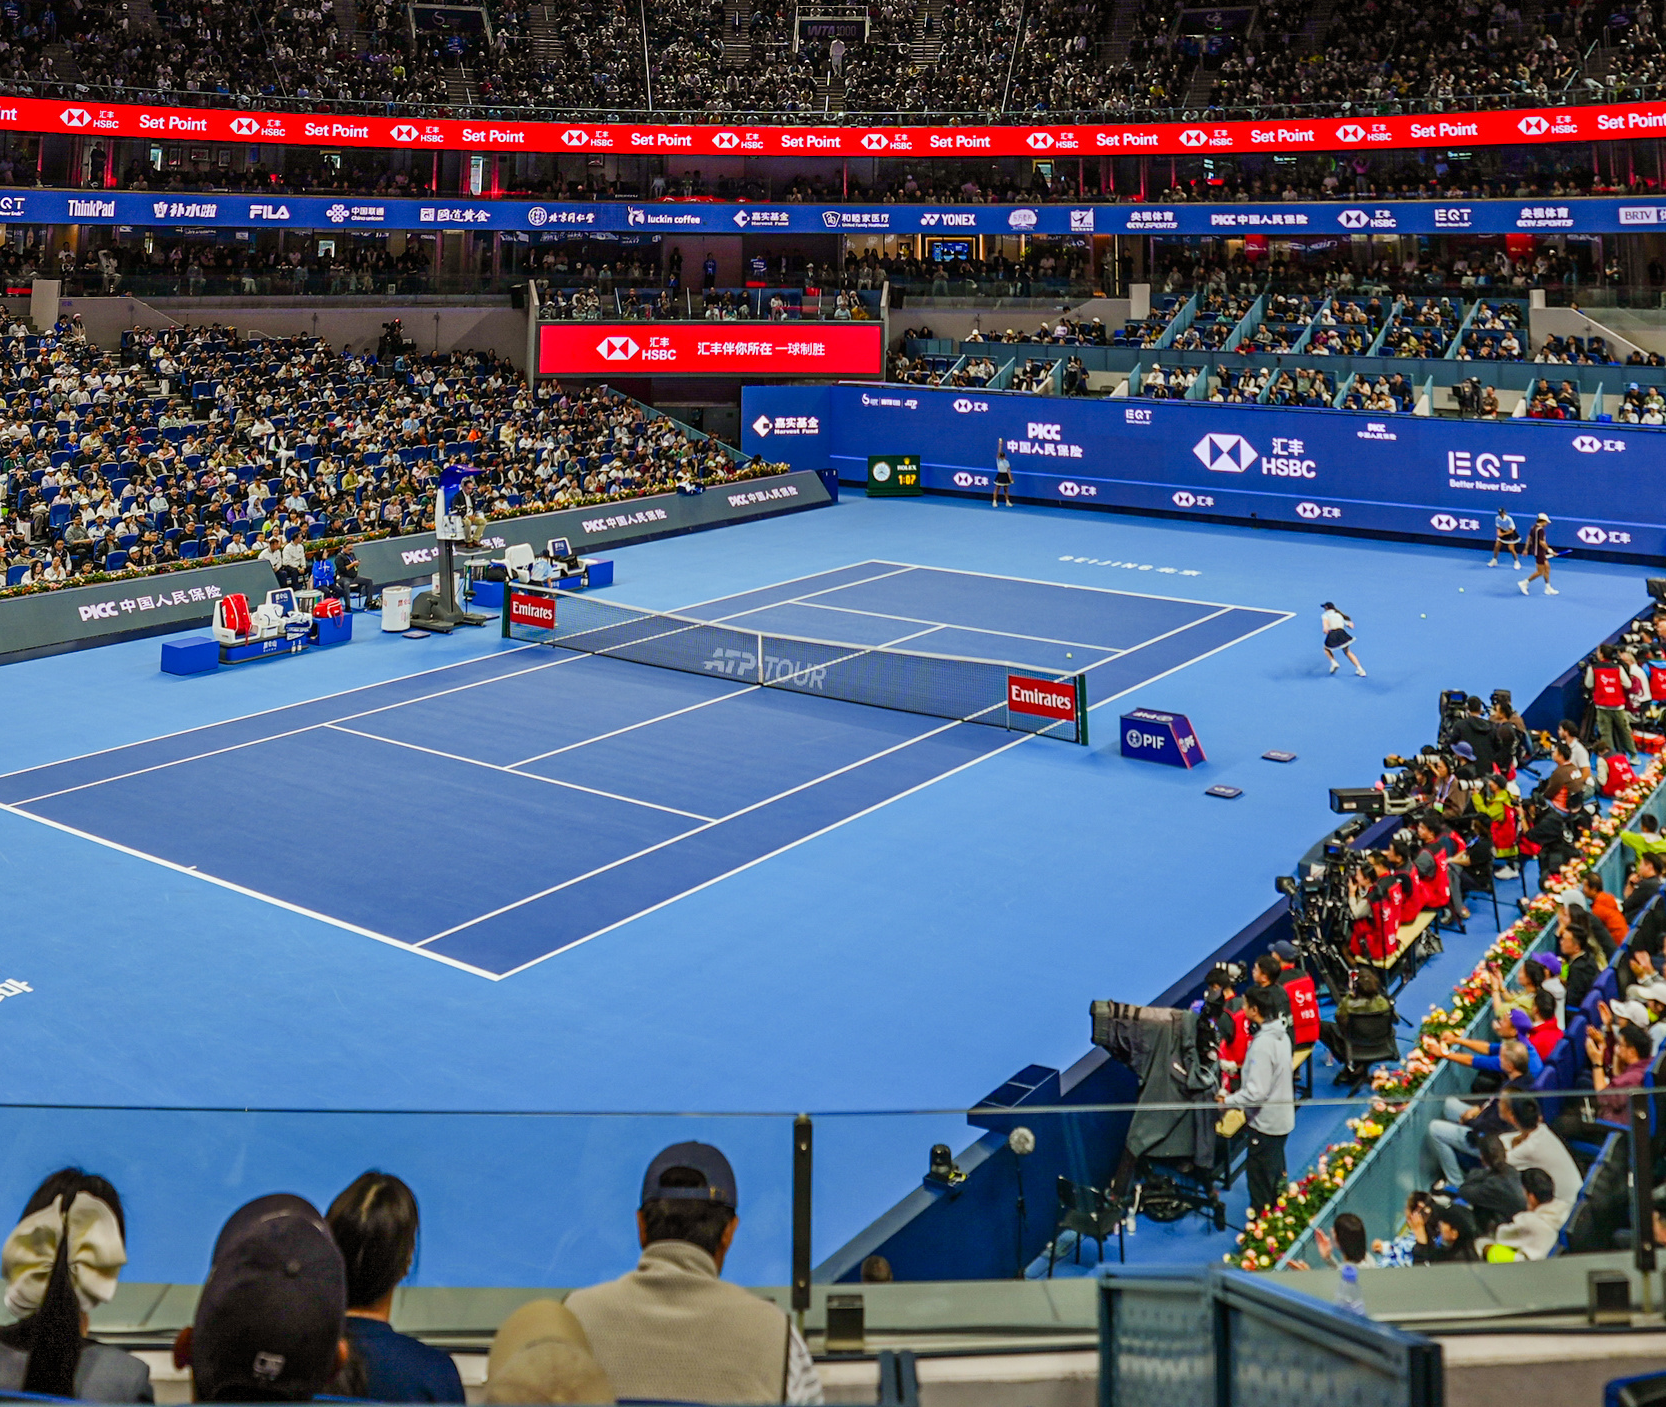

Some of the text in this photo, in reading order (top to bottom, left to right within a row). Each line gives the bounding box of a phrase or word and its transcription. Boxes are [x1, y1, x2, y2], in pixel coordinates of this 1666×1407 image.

[68, 200, 115, 217] ThinkPad
[170, 203, 217, 217] 补水啦
[250, 205, 290, 219] FILA
[351, 207, 384, 215] 中国联通
[1434, 209, 1472, 221] EQT
[1521, 207, 1568, 219] 央视体育
[1625, 211, 1652, 220] BRTV
[549, 212, 595, 223] 北京同仁堂
[648, 215, 700, 224] luckin coffee
[751, 211, 790, 222] 嘉实基金
[841, 213, 890, 224] 和睦家医疗
[941, 214, 976, 225] YONEX
[1131, 211, 1174, 221] 央视体育
[1211, 214, 1308, 225] PICC 中国人民保险
[1370, 219, 1396, 227] HSBC
[650, 337, 669, 347] 汇丰
[698, 342, 825, 356] 汇丰伴你所在 一球制胜
[642, 349, 676, 360] HSBC
[774, 416, 819, 429] 嘉实基金
[1028, 423, 1061, 440] PICC
[1007, 440, 1083, 458] 中国人民保险
[1272, 438, 1304, 456] 汇丰
[1262, 457, 1316, 478] HSBC
[1447, 450, 1527, 479] EQT
[898, 473, 917, 485] 1:07
[1450, 478, 1475, 490] Better
[1476, 480, 1500, 492] Never
[582, 509, 667, 533] PICC 中国人民保险
[401, 549, 432, 565] PICC
[78, 585, 222, 621] PICC 中国人民保险
[513, 601, 552, 619] Emirates
[704, 647, 826, 689] ATP TOUR
[1010, 685, 1071, 710] Emirates
[1143, 734, 1164, 749] PIF
